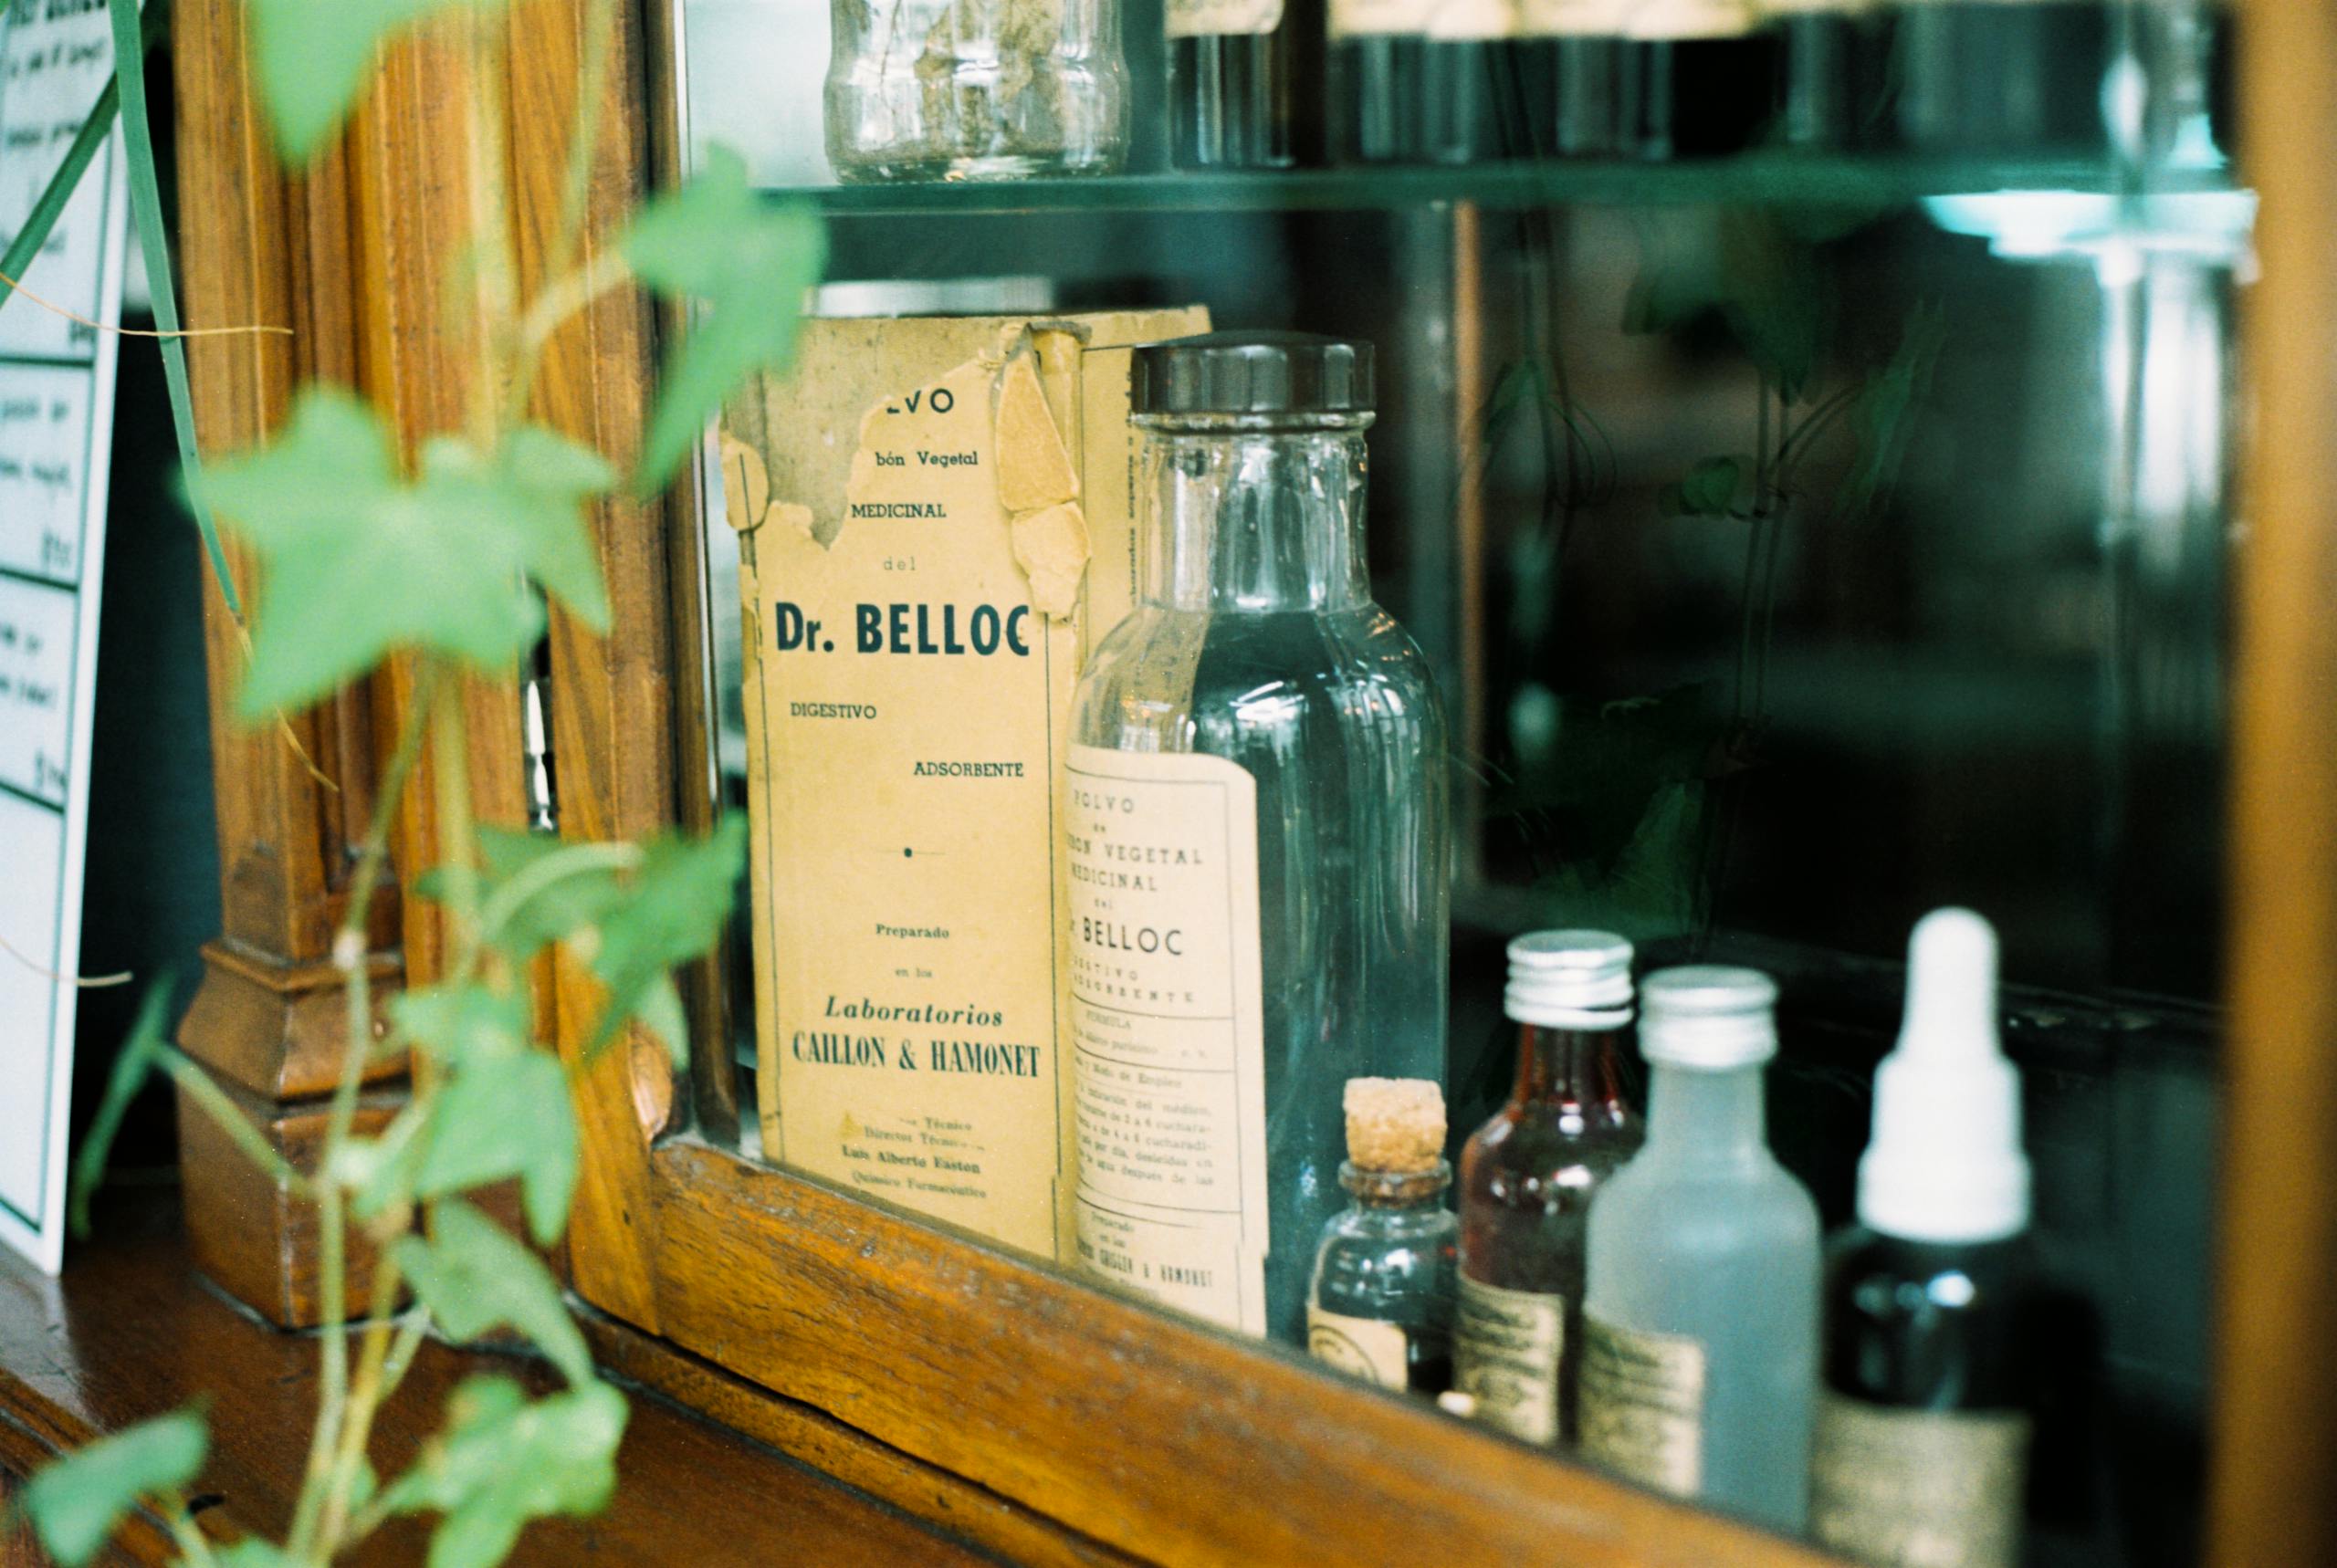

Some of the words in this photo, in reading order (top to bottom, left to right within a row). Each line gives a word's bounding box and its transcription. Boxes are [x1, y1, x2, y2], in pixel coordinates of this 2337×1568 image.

[886, 388, 954, 414] VO
[875, 451, 906, 466] bón
[917, 451, 979, 468] Vegetal
[852, 504, 947, 518] MEDICINAL
[883, 557, 916, 571] del
[775, 601, 834, 653] Dr.
[855, 602, 1030, 656] BELLOC
[791, 702, 877, 720] DIGESTIVO
[913, 761, 1024, 778] ADSORBENTE
[1105, 842, 1203, 864] VEGETAL
[1071, 861, 1158, 892] MEDICINAL
[875, 923, 950, 939] Preparado
[1084, 915, 1182, 956] BELLOC
[824, 994, 1003, 1027] Laboratorios
[792, 1030, 886, 1067] CAILLON
[898, 1039, 917, 1071] &
[930, 1040, 1041, 1078] HAMONET
